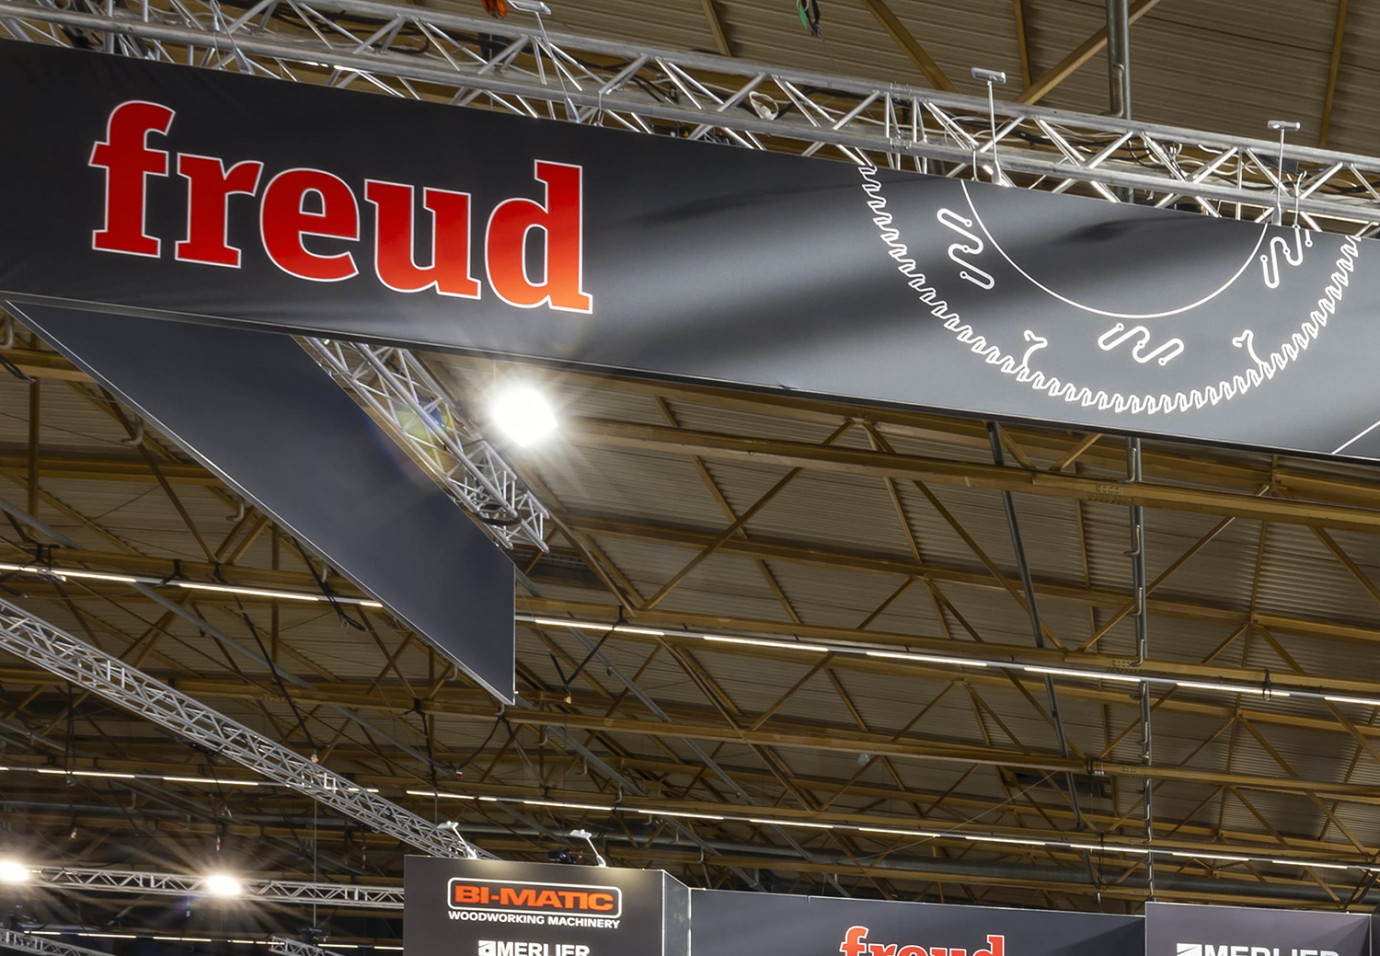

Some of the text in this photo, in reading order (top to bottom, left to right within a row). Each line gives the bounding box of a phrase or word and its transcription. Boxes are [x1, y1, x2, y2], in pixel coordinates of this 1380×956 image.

[88, 100, 593, 314] freud
[455, 885, 614, 911] BI-MATIC
[448, 911, 621, 929] WOODWORKING MACHINERY
